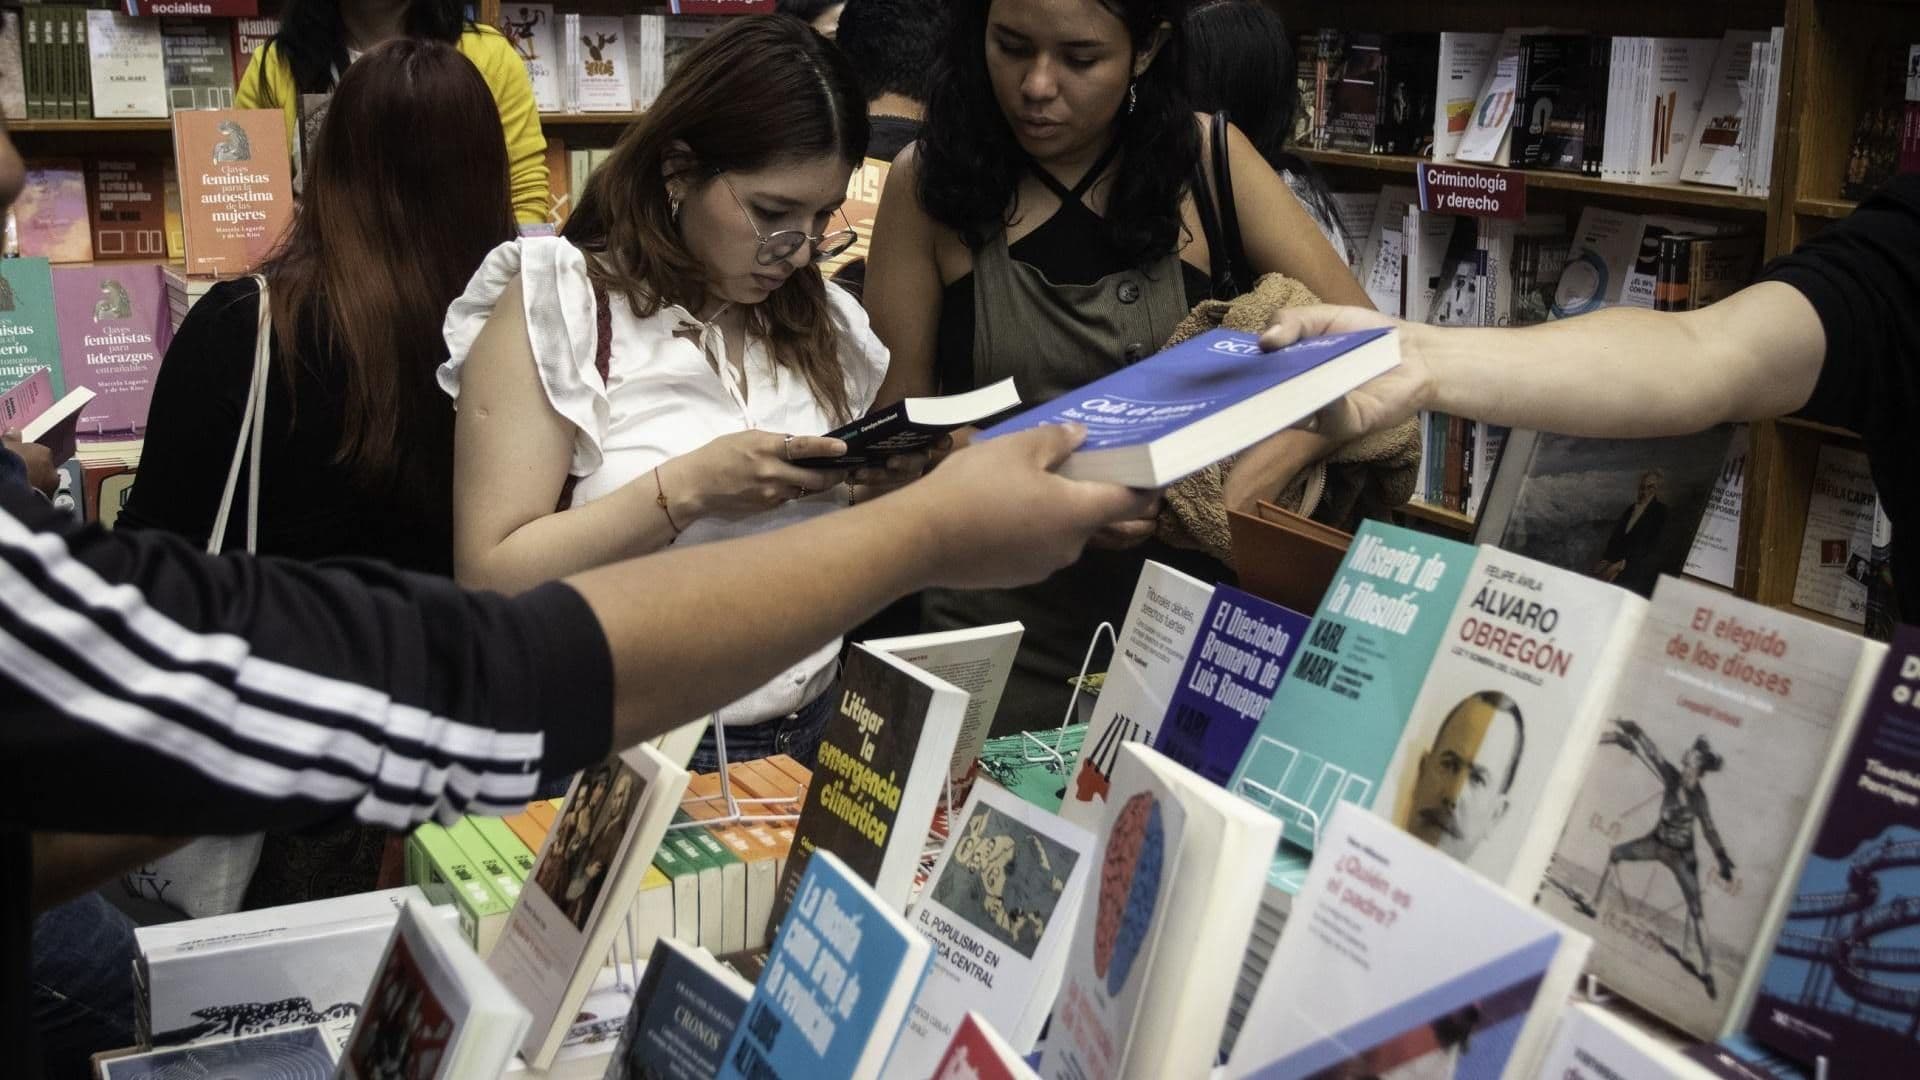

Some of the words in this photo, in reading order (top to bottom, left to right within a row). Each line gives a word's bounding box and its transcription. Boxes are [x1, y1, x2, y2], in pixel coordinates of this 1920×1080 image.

[152, 3, 212, 14] socialista
[202, 173, 269, 185] feministas
[221, 166, 248, 174] Claves
[1427, 169, 1507, 191] Criminología
[201, 190, 273, 203] autoestima
[1437, 195, 1444, 209] y
[1447, 192, 1499, 211] derecho
[212, 209, 266, 224] mujeres
[0, 325, 34, 336] istas
[84, 333, 152, 346] feministas
[103, 326, 131, 334] Claves
[87, 352, 154, 365] liderazgos
[109, 346, 129, 354] para
[1347, 533, 1422, 585] Miseria
[1413, 552, 1448, 593] de
[1485, 564, 1515, 582] FELIPE
[1326, 575, 1351, 614] la
[1343, 580, 1420, 636] filosofía
[1470, 579, 1559, 634] ÁLVARO
[1211, 600, 1232, 632] El
[1226, 607, 1290, 657] Dieciocho
[1308, 618, 1346, 654] KARL
[1459, 616, 1573, 679] OBREGÓN
[1691, 606, 1713, 633] El
[1714, 616, 1788, 658] elegido
[1199, 631, 1262, 681] Brumario
[1258, 657, 1280, 690] de
[1292, 650, 1338, 689] MARX
[1666, 632, 1690, 660] de
[1692, 640, 1720, 671] los
[1722, 652, 1792, 697] dioses
[1188, 660, 1219, 697] Luis
[1214, 673, 1271, 721] Bonapar
[840, 689, 885, 736] Litigar
[859, 732, 876, 763] la
[818, 740, 902, 813] emergencia
[820, 778, 888, 849] climática
[1391, 889, 1412, 910] es
[919, 908, 931, 924] EL
[930, 916, 985, 959] POPULISMO
[983, 948, 1000, 970] EN
[783, 917, 821, 972] como
[811, 947, 847, 1004] arma
[837, 970, 861, 1020] de
[950, 949, 994, 989] CENTRAL
[765, 951, 786, 997] la
[776, 971, 836, 1058] revolución
[674, 1004, 721, 1051] CRONOS
